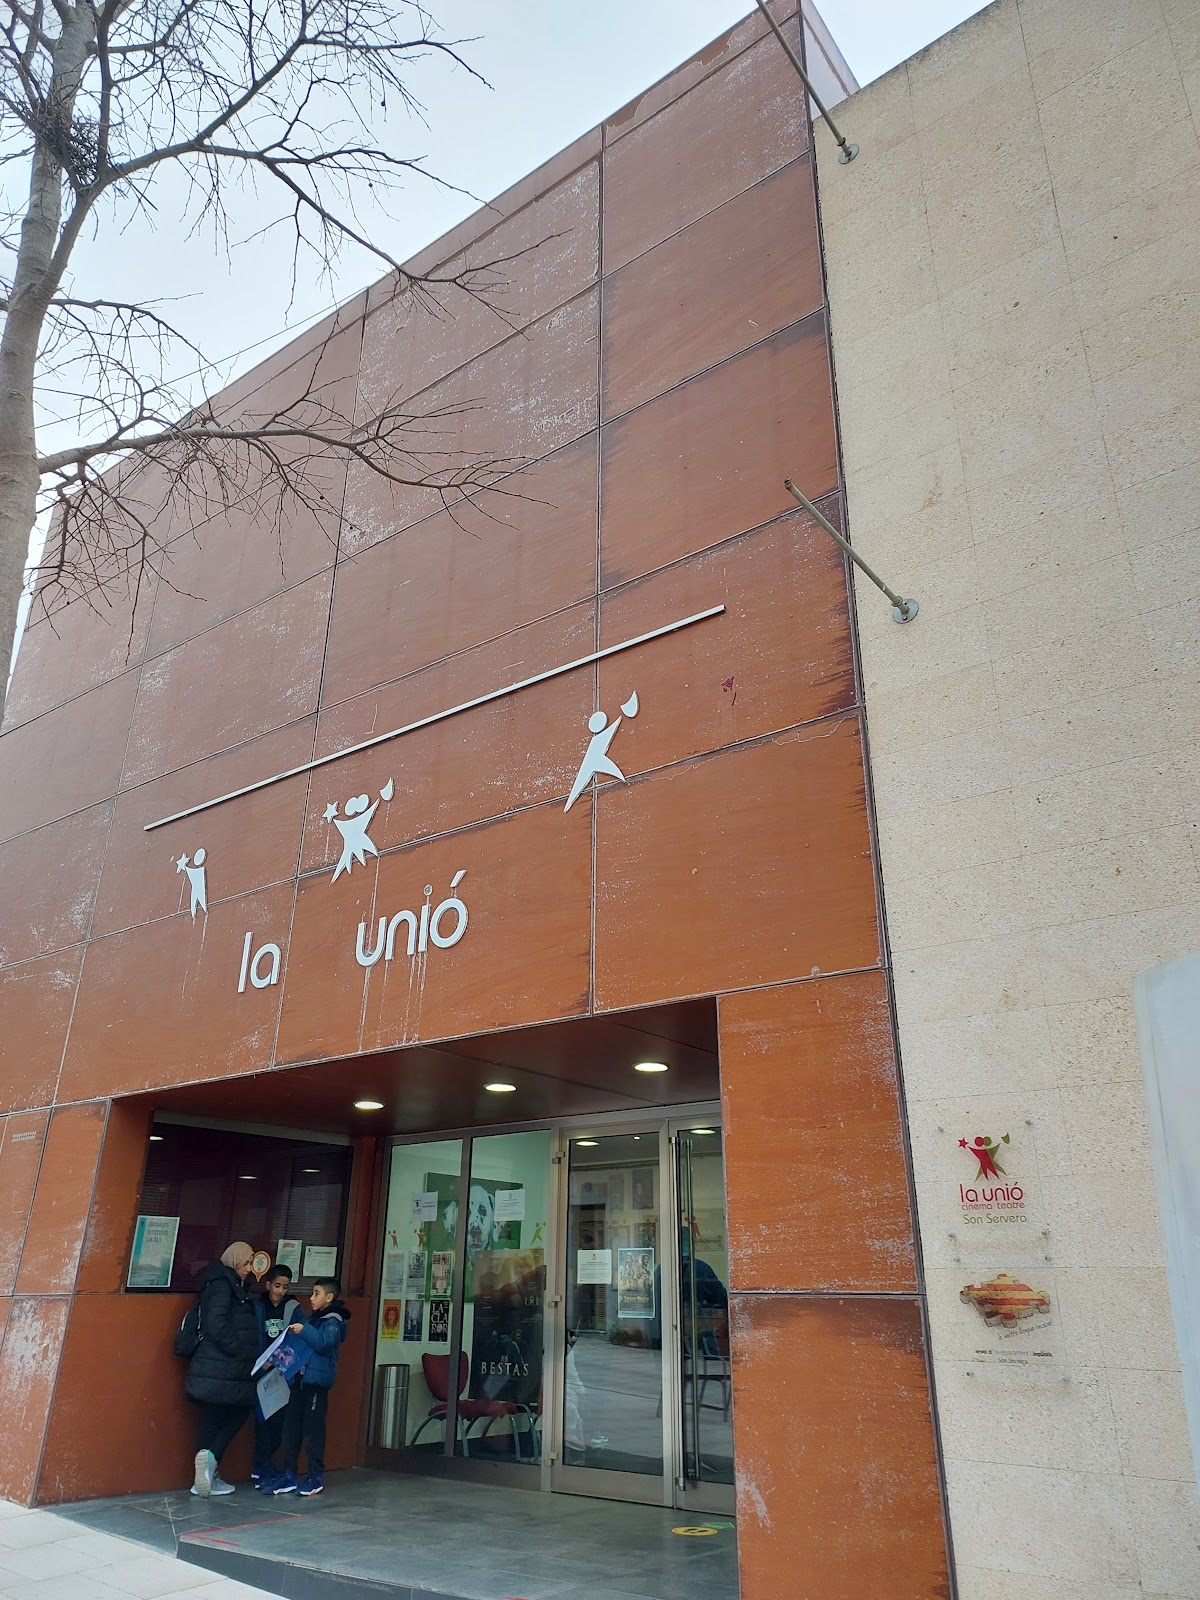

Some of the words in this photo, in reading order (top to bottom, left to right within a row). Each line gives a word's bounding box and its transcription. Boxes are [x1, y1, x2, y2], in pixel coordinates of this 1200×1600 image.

[238, 932, 281, 993] la
[356, 870, 468, 967] unió
[960, 1183, 979, 1203] la
[982, 1181, 1024, 1202] unió
[961, 1203, 993, 1211] cinema
[997, 1202, 1025, 1210] teatre
[963, 1214, 983, 1225] Son
[986, 1213, 1027, 1224] Servera
[432, 1303, 444, 1313] LA
[481, 1361, 529, 1377] BESTAS
